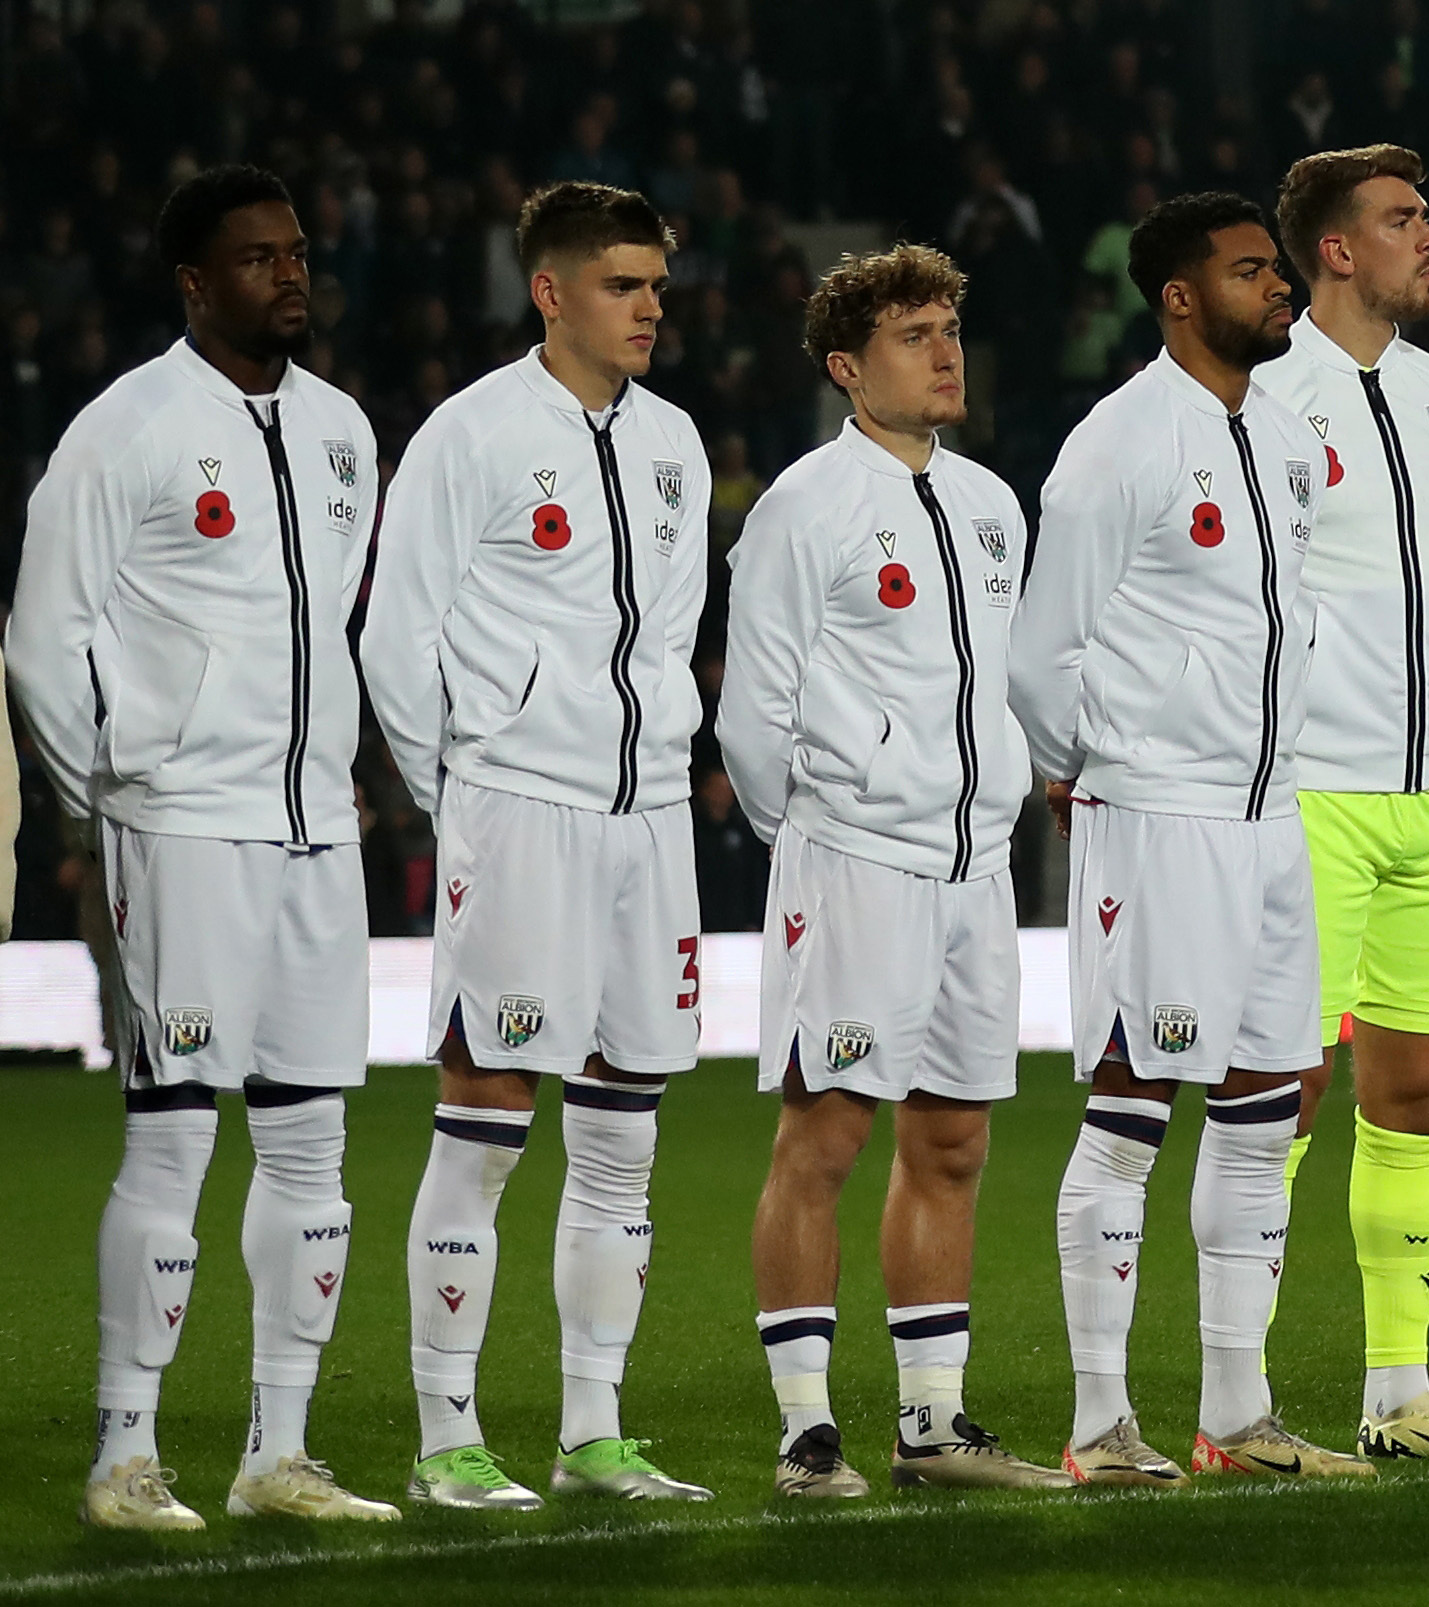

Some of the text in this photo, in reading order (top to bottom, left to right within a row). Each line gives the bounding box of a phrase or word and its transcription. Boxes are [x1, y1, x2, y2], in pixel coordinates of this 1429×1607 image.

[677, 936, 699, 1010] 3
[501, 1001, 541, 1014] ALBION
[168, 1012, 210, 1025] ALBION
[1156, 1012, 1196, 1023] ALBION
[832, 1027, 871, 1041] ALBION
[303, 1223, 350, 1242] WBA
[427, 1240, 480, 1256] WBA
